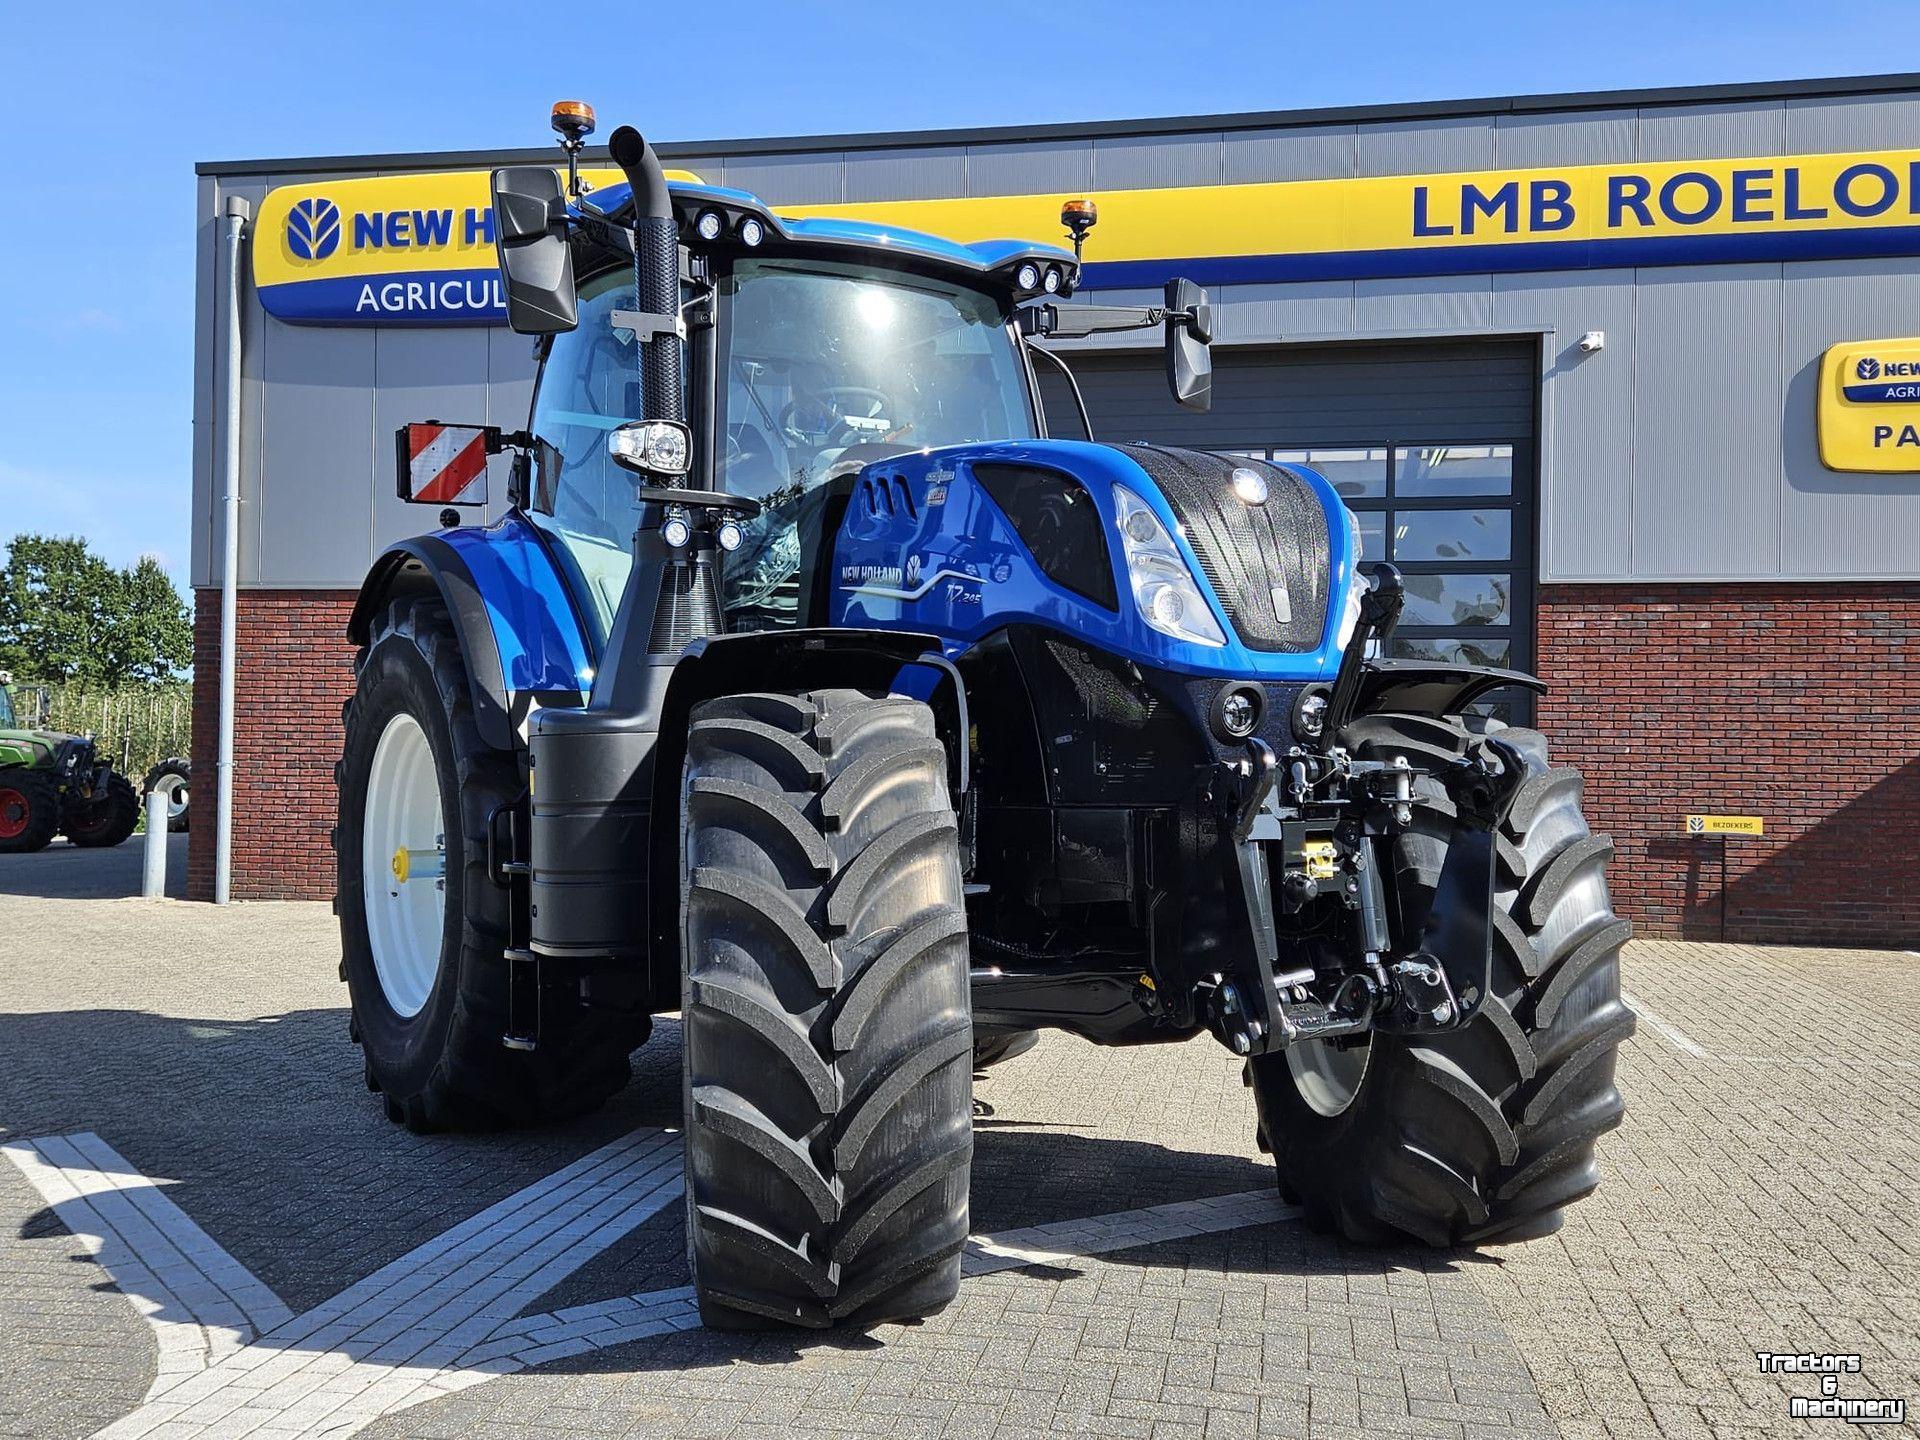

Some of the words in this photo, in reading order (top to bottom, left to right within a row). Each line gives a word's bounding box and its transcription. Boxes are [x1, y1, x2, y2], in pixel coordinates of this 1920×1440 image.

[1413, 180, 1576, 237] LMB
[354, 209, 453, 249] NEW
[842, 566, 860, 581] NEW
[861, 566, 903, 584] HOLLAND
